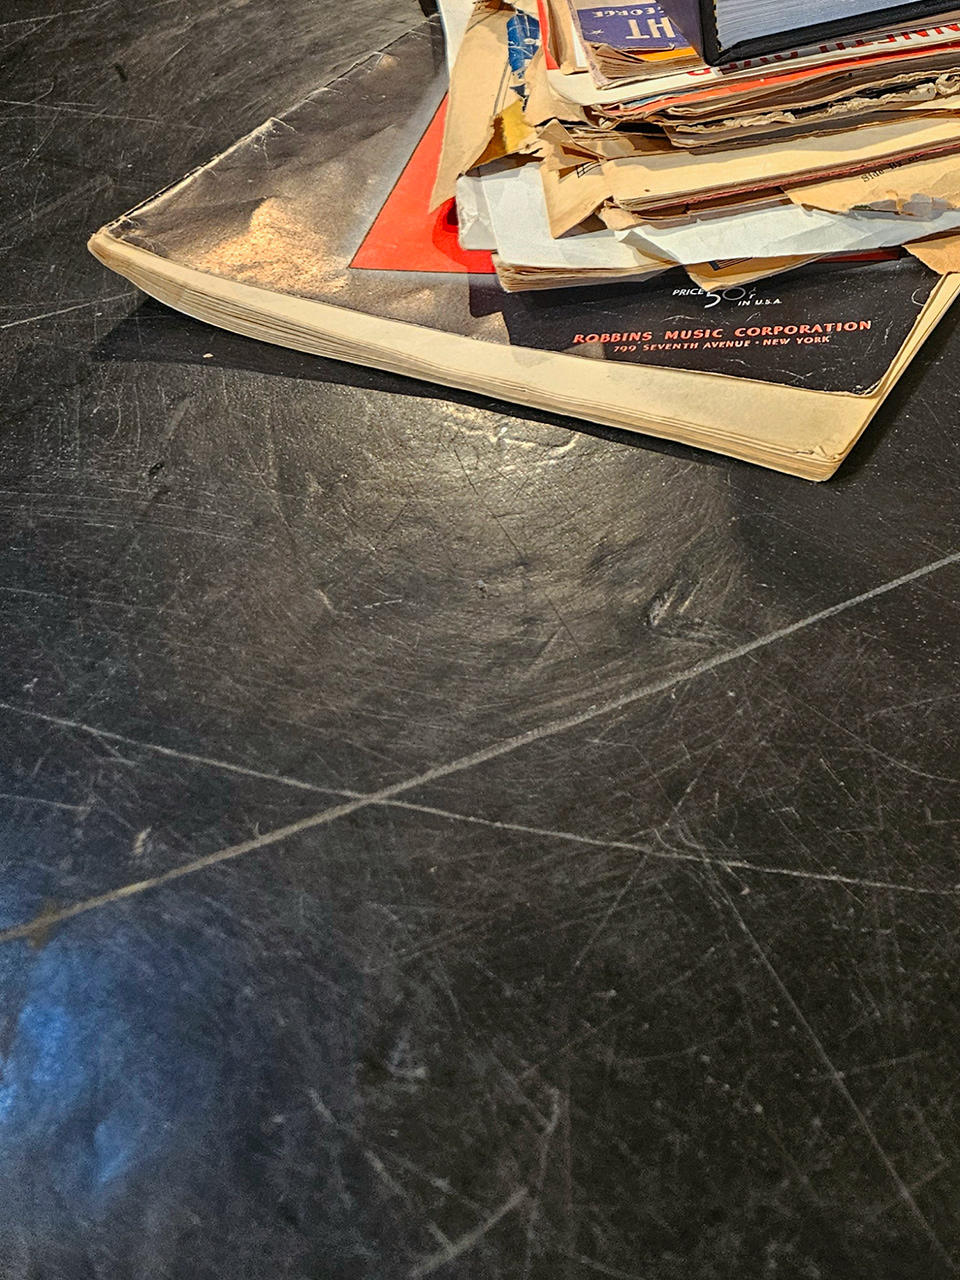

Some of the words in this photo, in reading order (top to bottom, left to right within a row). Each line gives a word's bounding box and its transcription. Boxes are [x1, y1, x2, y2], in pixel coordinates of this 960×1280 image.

[672, 288, 704, 296] PRICE
[572, 331, 653, 344] ROBBINS
[664, 328, 724, 340] MUSIC
[734, 320, 873, 337] CORPORATION
[613, 345, 637, 353] 799
[643, 342, 699, 352] SEVENTH
[702, 339, 751, 349] AVENUE
[762, 337, 790, 346] NEW
[796, 335, 832, 345] YORK
